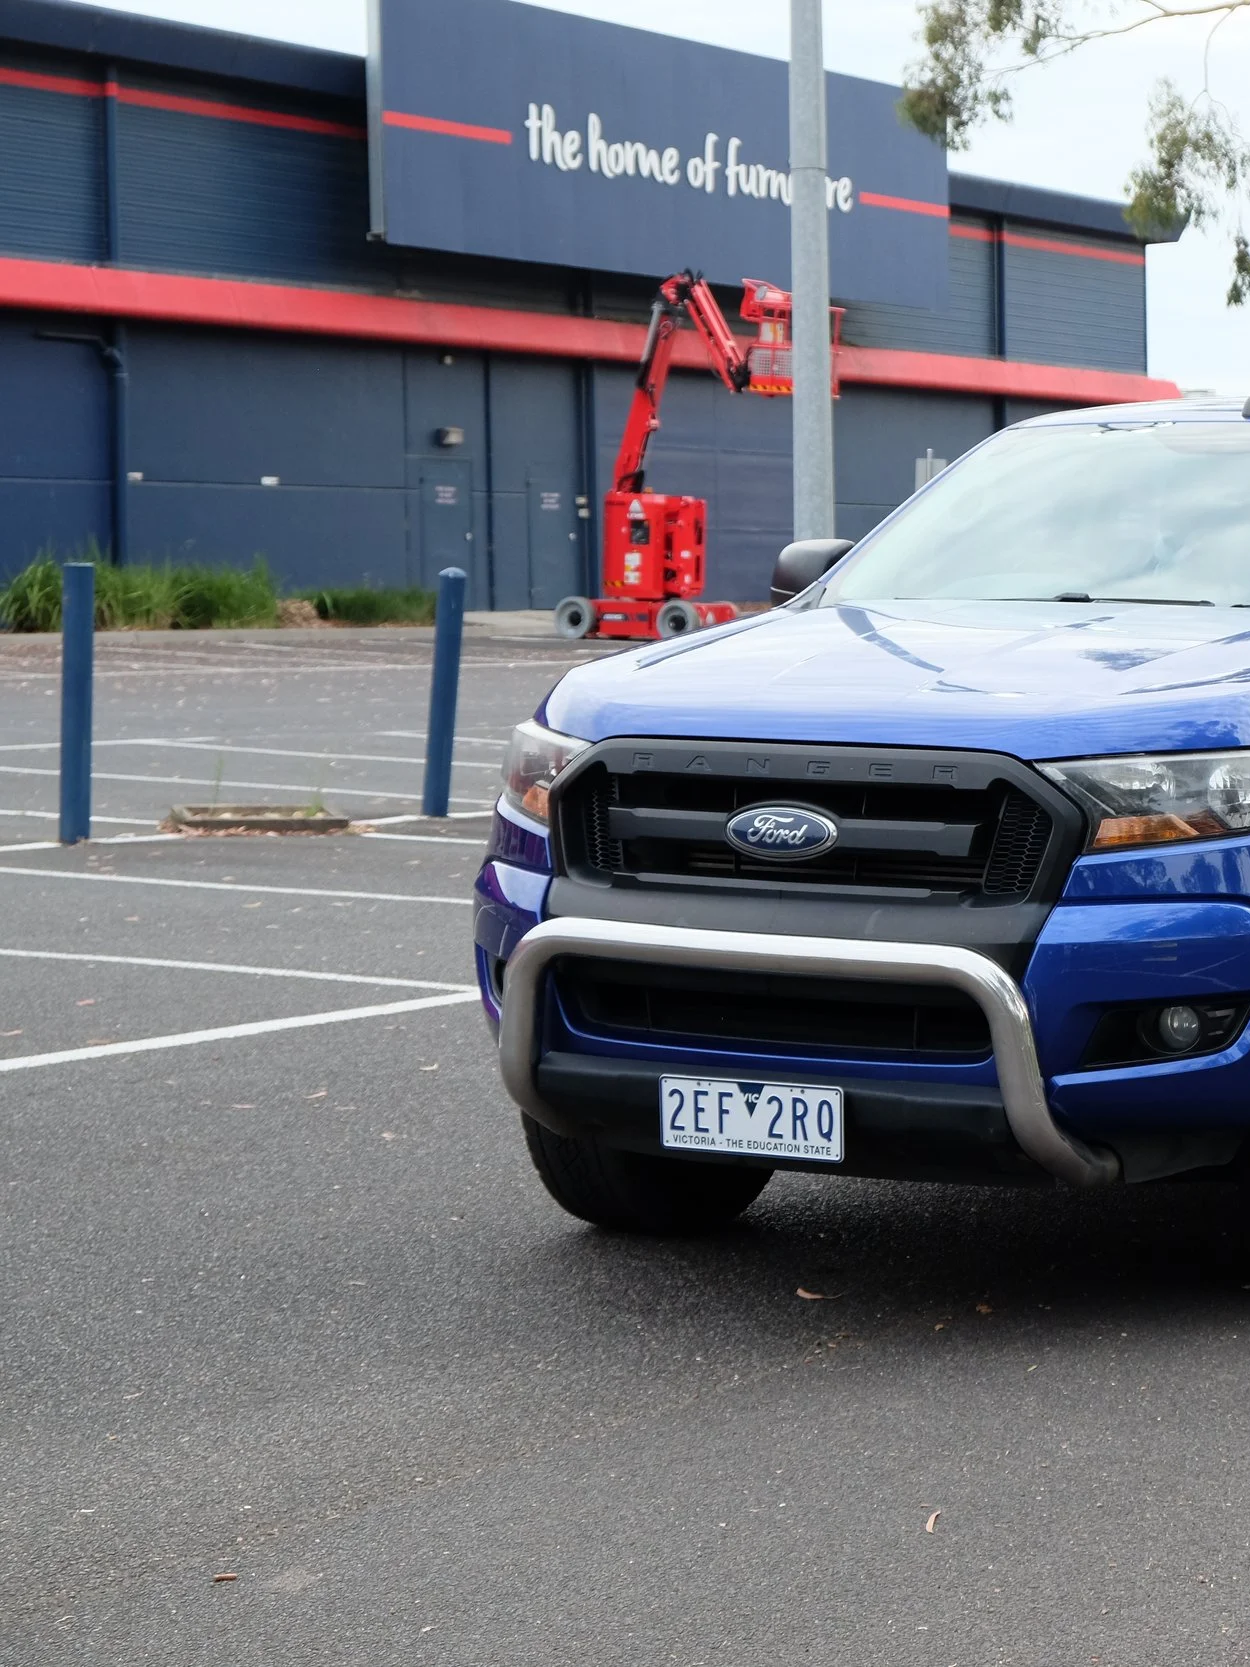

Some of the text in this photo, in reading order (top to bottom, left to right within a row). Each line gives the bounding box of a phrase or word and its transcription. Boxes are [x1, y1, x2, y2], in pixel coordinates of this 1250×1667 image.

[525, 103, 582, 171] the
[588, 113, 680, 186] home
[687, 132, 722, 194] of
[630, 752, 960, 782] RANGER
[747, 814, 808, 845] Ford
[668, 1088, 834, 1142] 2EF 2RQ
[673, 1134, 717, 1147] VICTORIA
[726, 1138, 744, 1149] THE
[747, 1140, 801, 1153] EDUCATION
[804, 1146, 832, 1156] STATE
